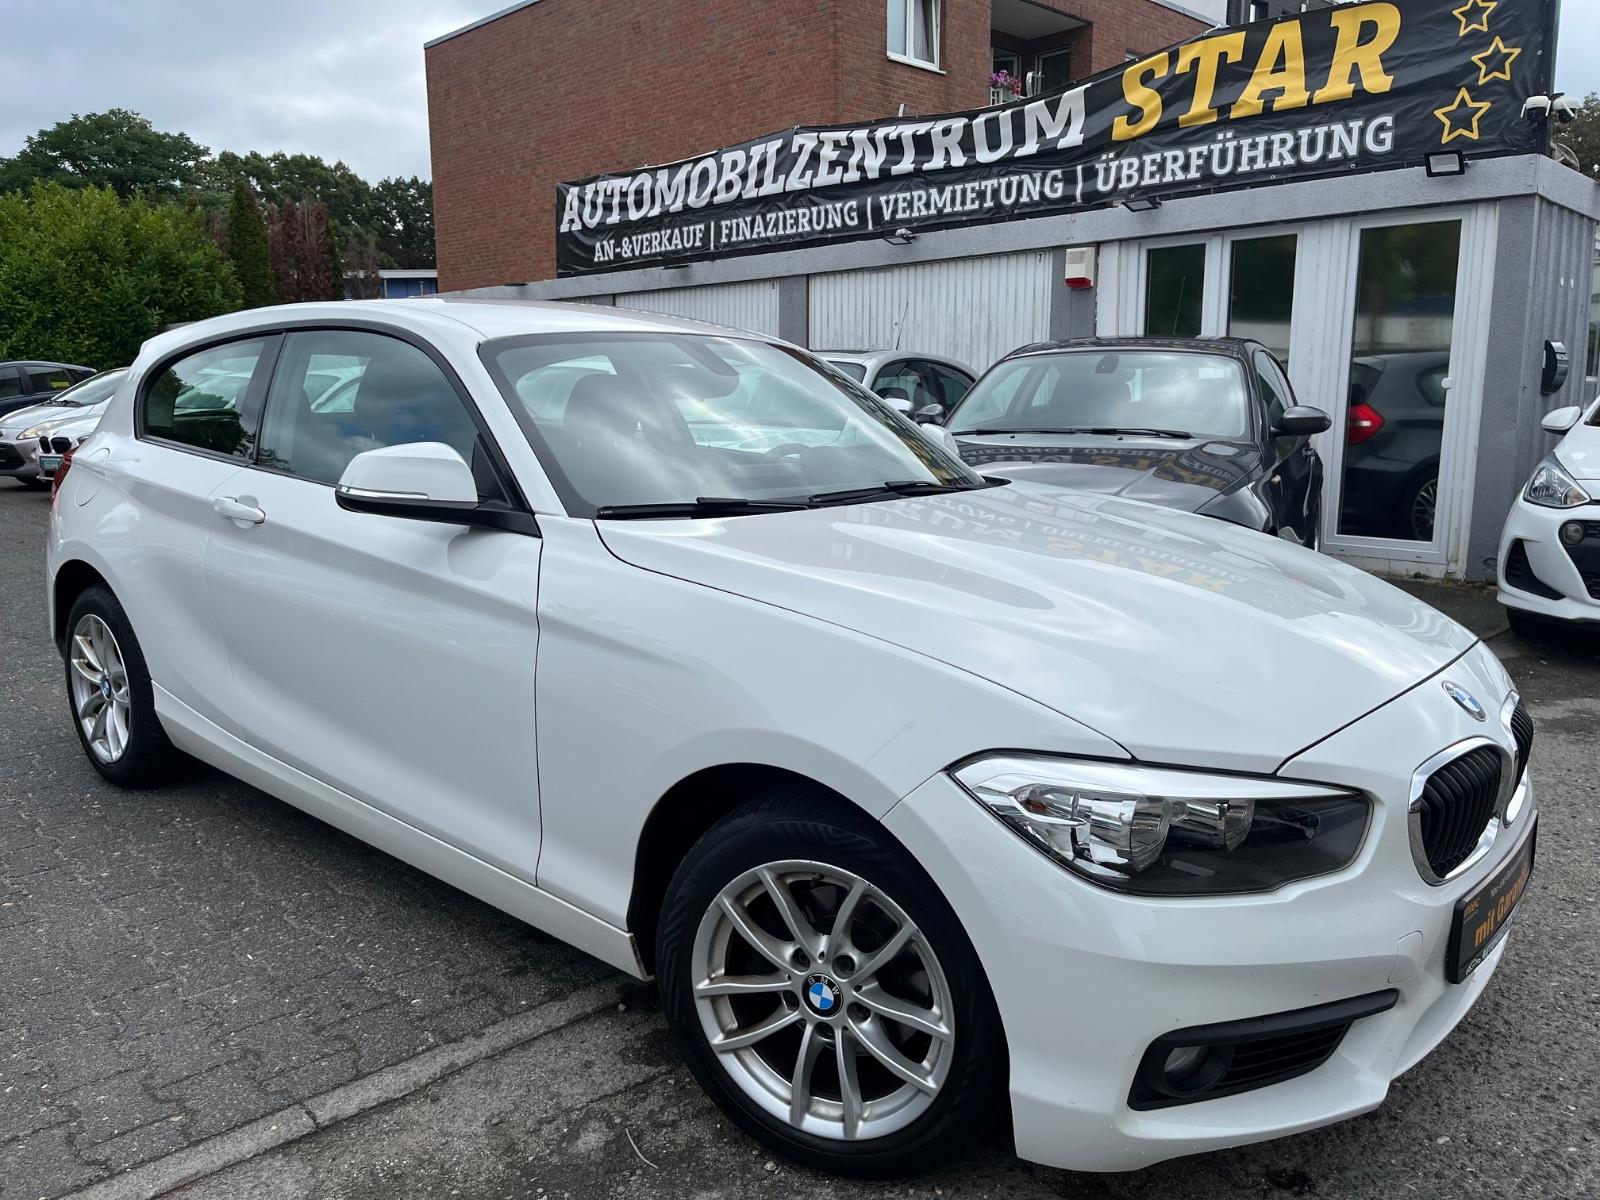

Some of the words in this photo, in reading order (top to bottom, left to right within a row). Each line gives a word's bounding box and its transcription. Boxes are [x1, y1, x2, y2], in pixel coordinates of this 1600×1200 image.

[559, 82, 1092, 233] AUTOMOBILZENTRUM
[1111, 2, 1402, 141] STAR
[593, 225, 705, 262] AN-&VERKAUF
[720, 201, 859, 242] FINAZIERUNG
[880, 169, 1063, 219] VERMIETUNG
[1095, 116, 1394, 192] ÜBERFÜHRUNG
[808, 976, 840, 995] BMW
